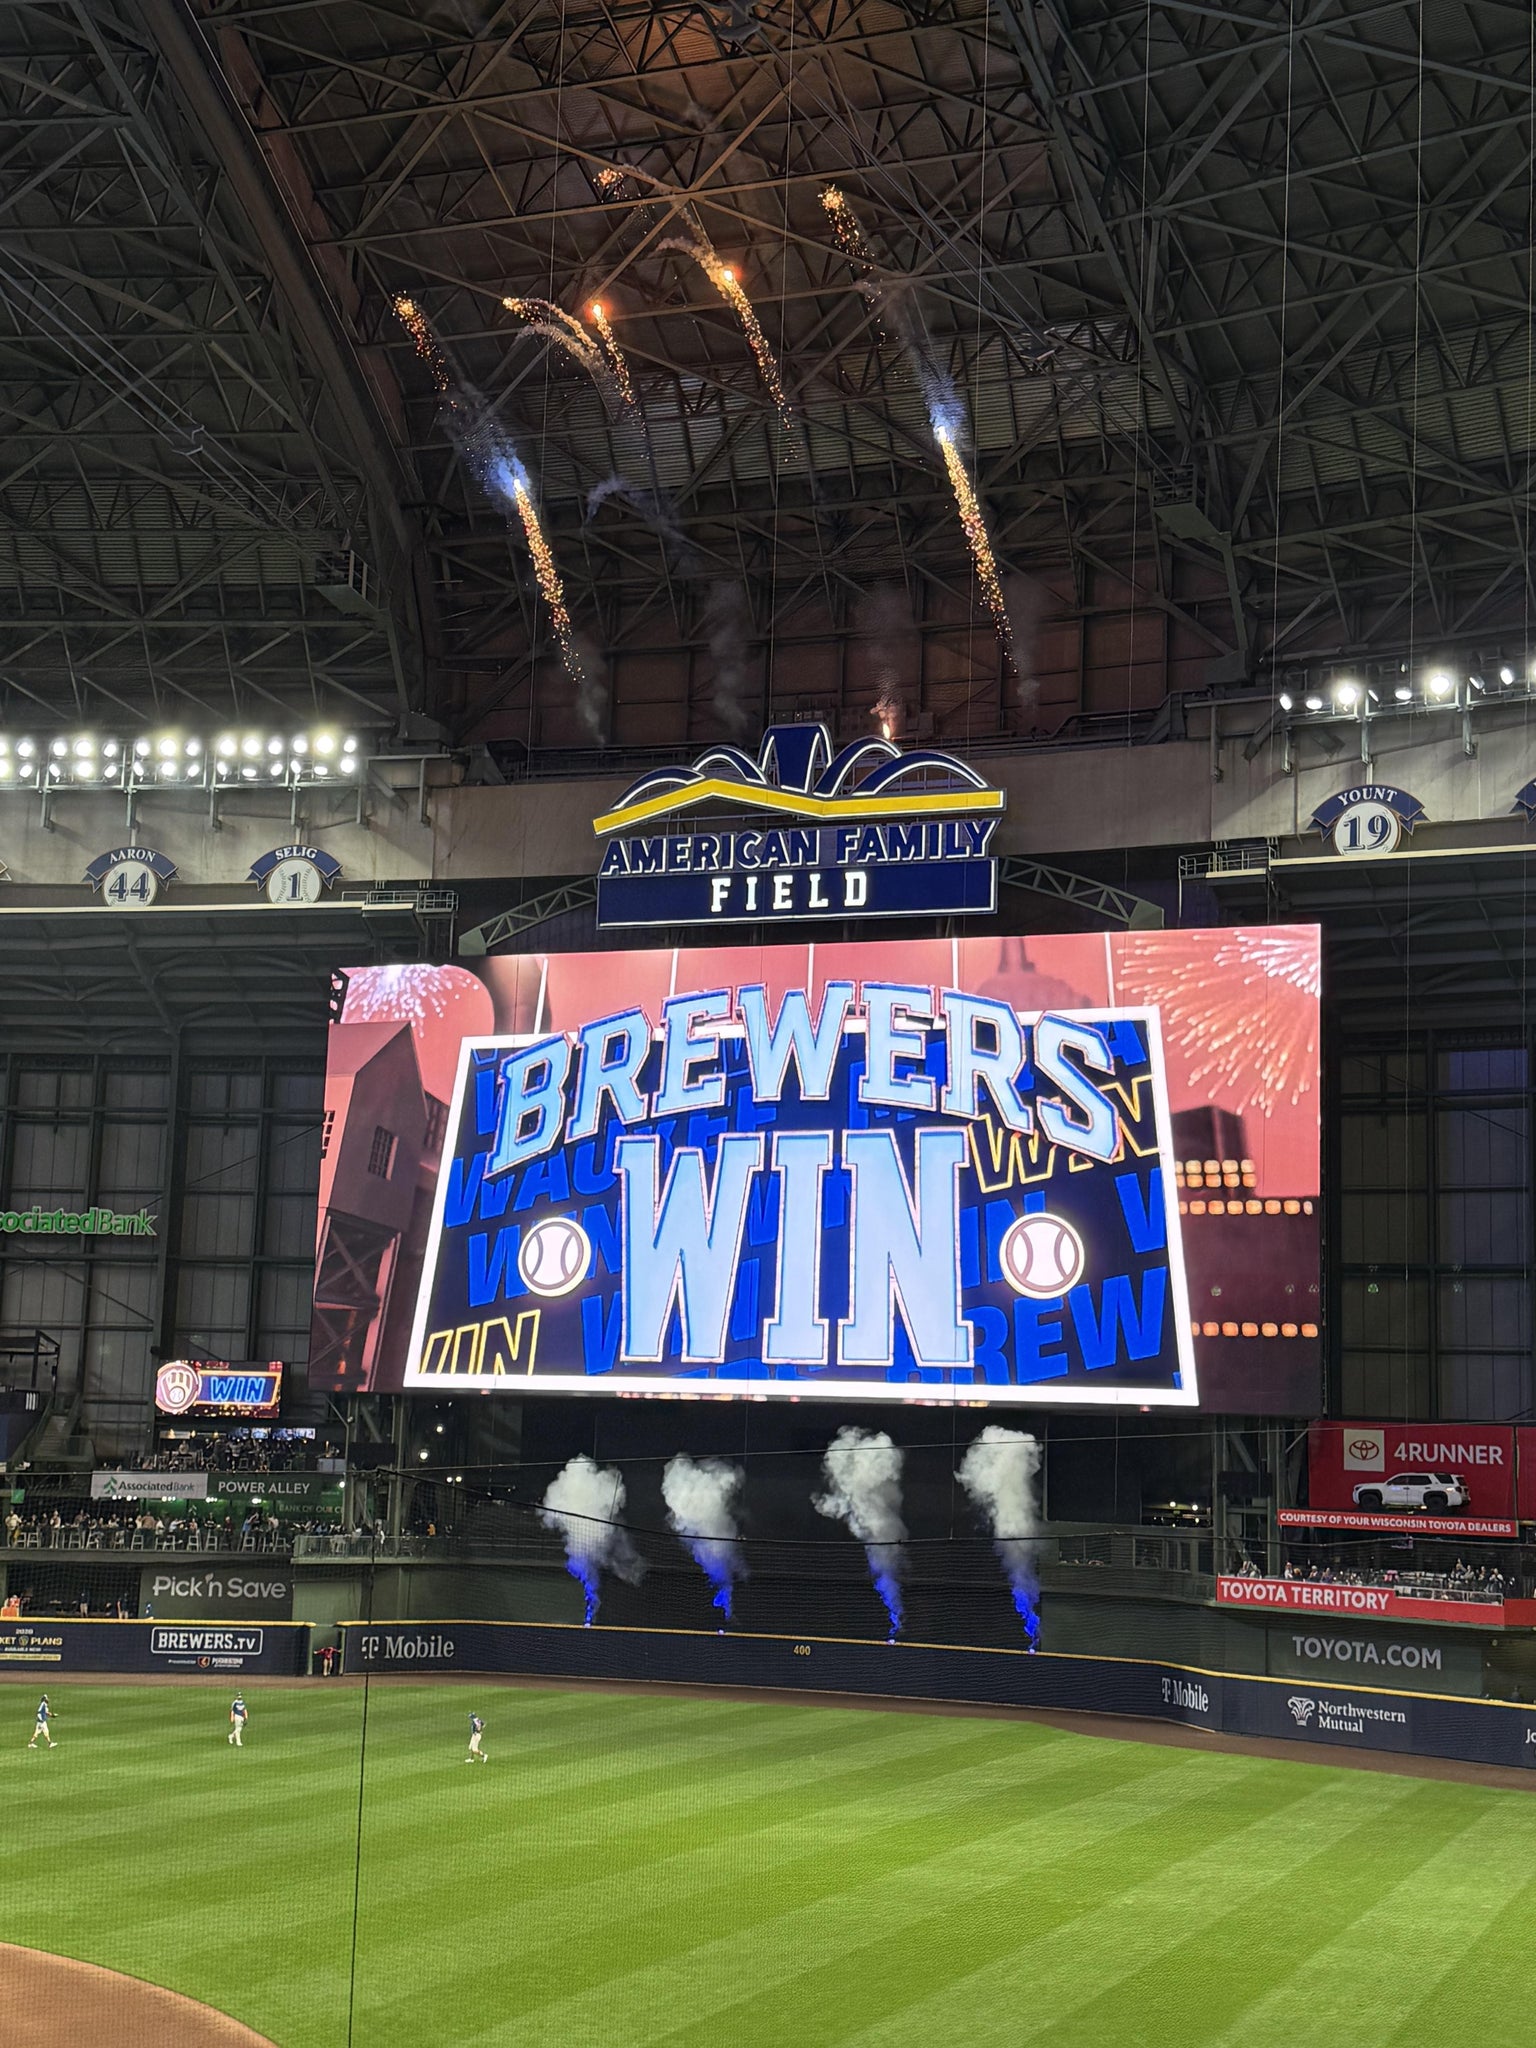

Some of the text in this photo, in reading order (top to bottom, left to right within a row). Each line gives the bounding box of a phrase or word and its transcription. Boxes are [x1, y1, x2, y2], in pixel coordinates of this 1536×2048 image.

[1338, 787, 1398, 806] YOUNT
[1343, 814, 1392, 851] 19
[109, 848, 156, 864] AARON
[275, 846, 318, 861] SELIG
[601, 820, 998, 876] AMERICAN FAMILY
[108, 872, 150, 901] 44
[286, 871, 303, 902] 1
[711, 871, 867, 912] FIELD
[483, 980, 1120, 1165] BREWERS
[613, 1128, 975, 1368] WIN
[211, 1376, 266, 1403] WIN
[1394, 1442, 1504, 1465] 4RUNNER
[218, 1481, 265, 1493] POWER
[268, 1482, 310, 1494] ALLEY
[1280, 1513, 1511, 1533] COURTESY OF YOUR WISCONSIN TOYOTA DEALERS
[153, 1576, 203, 1597] Pick
[227, 1578, 287, 1598] Save
[1221, 1581, 1390, 1610] TOYOTA TERRITORY
[30, 1637, 63, 1646] PLANS
[158, 1632, 256, 1650] BREWERS.TV
[384, 1635, 455, 1659] Mobile
[793, 1645, 811, 1656] 400
[1292, 1636, 1442, 1671] TOYOTA.COM
[1172, 1680, 1209, 1713] Mobile
[1318, 1700, 1406, 1723] Northwestern
[1318, 1715, 1363, 1734] Mutual
